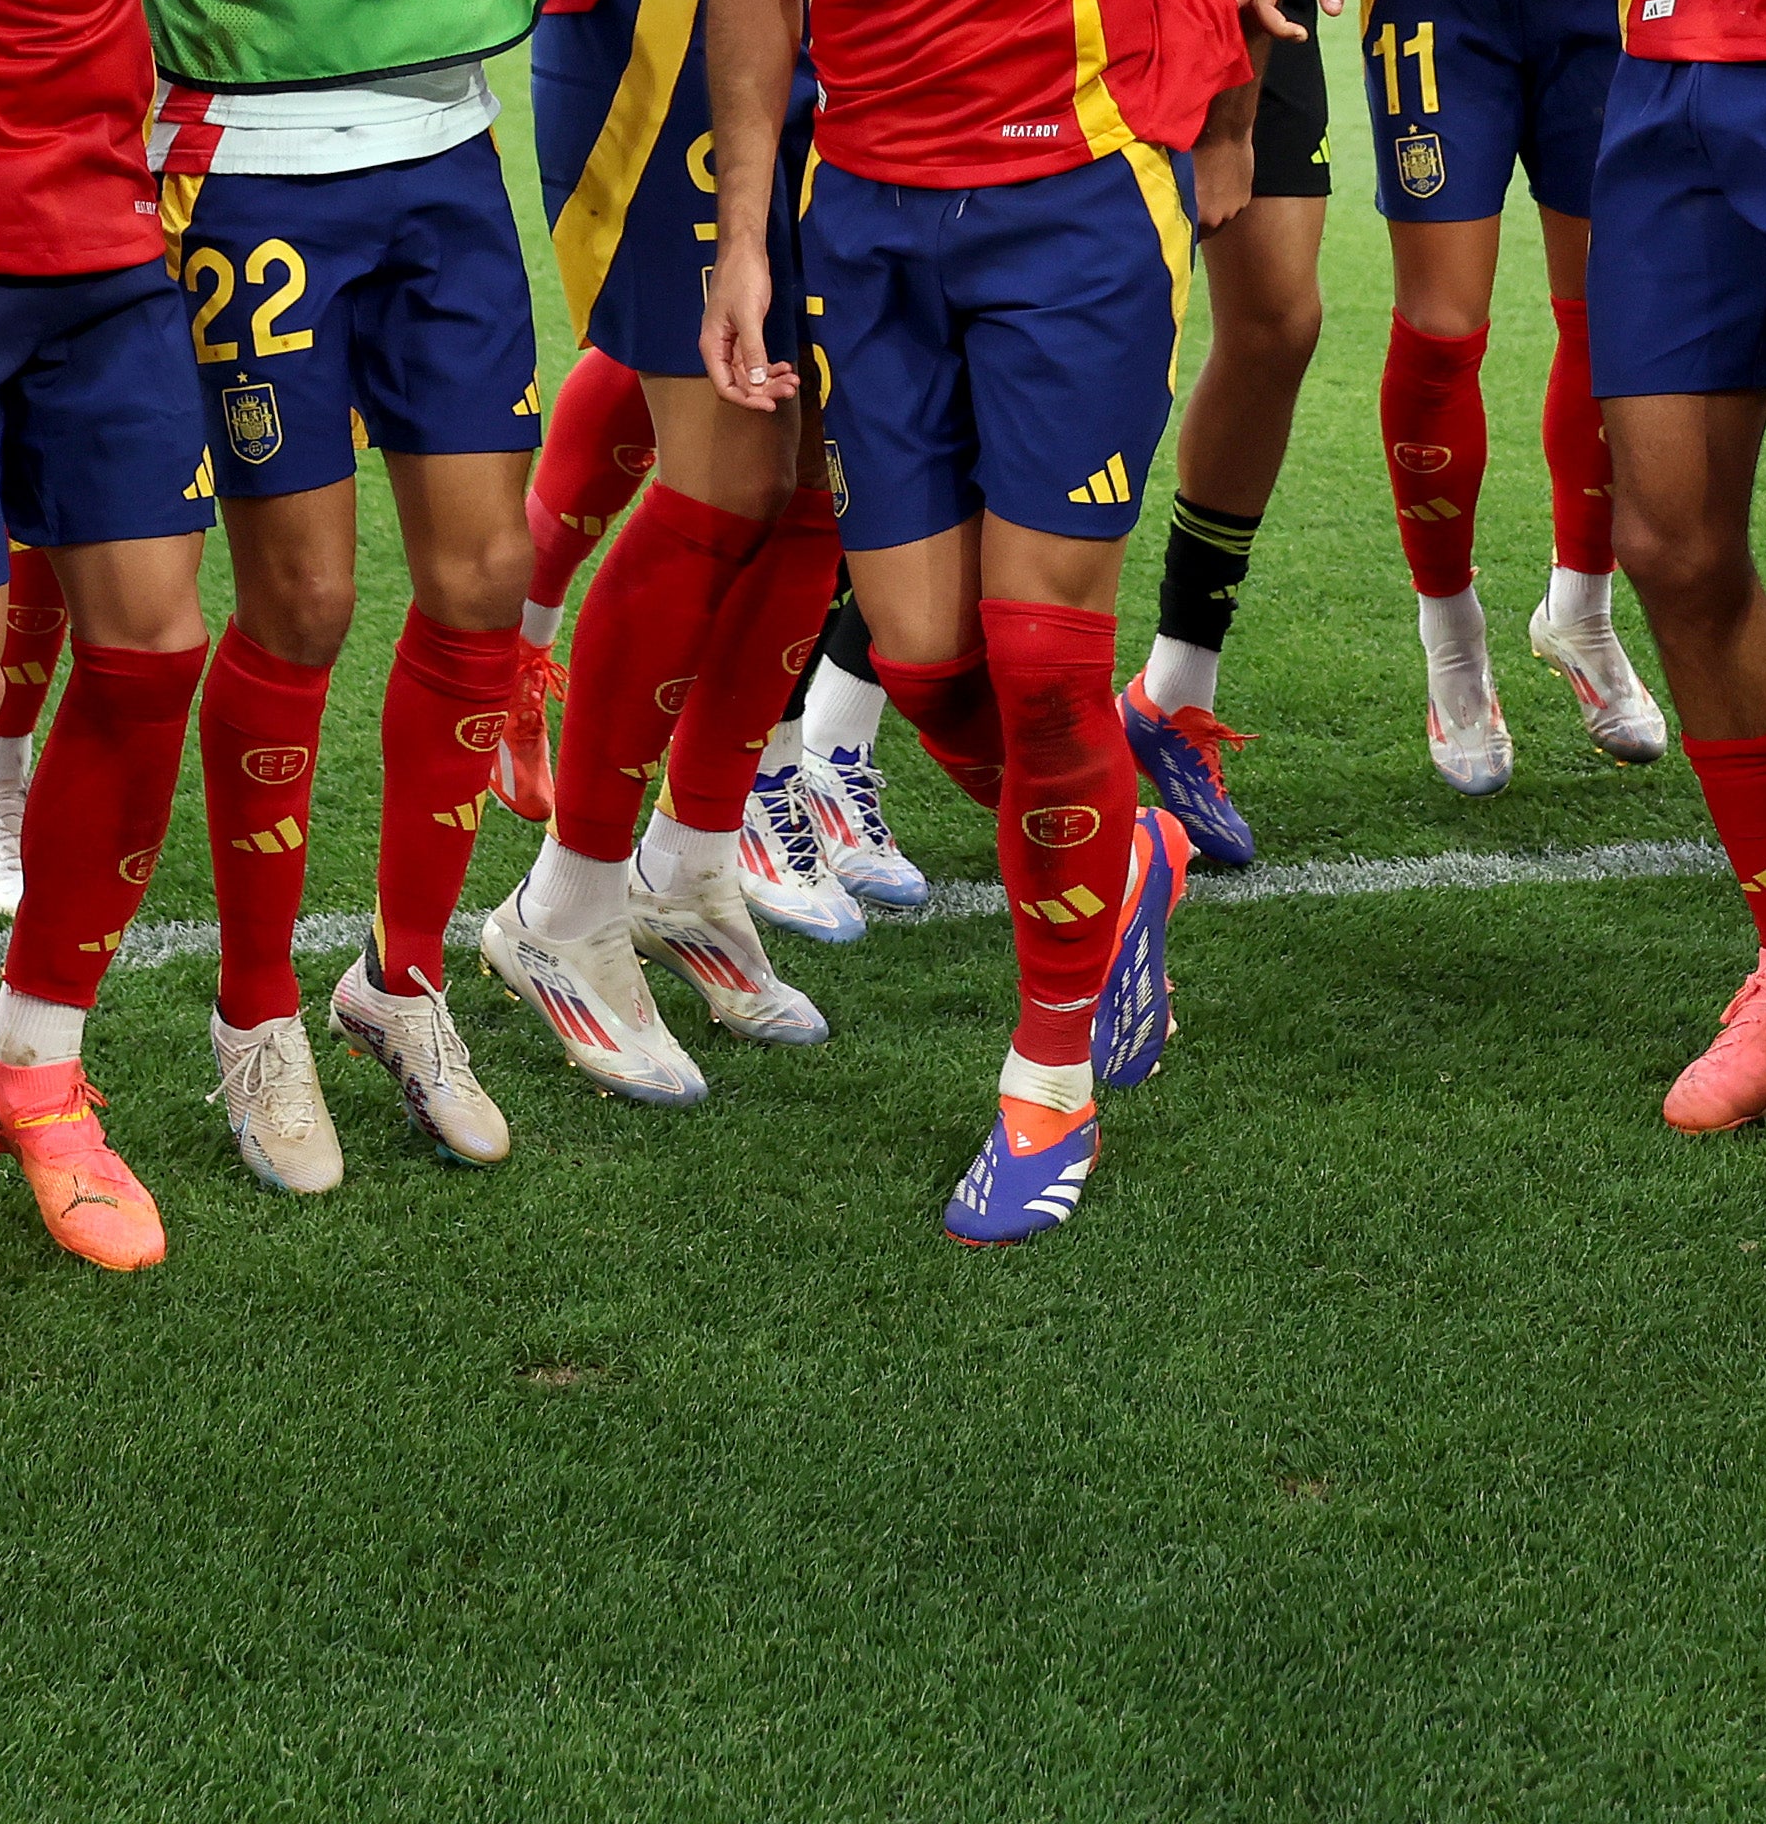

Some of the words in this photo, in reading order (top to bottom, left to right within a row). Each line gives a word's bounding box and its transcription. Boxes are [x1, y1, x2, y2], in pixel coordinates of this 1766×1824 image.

[1372, 21, 1440, 115] 11
[1002, 124, 1060, 138] HEAT.RDY
[185, 238, 313, 365] 22
